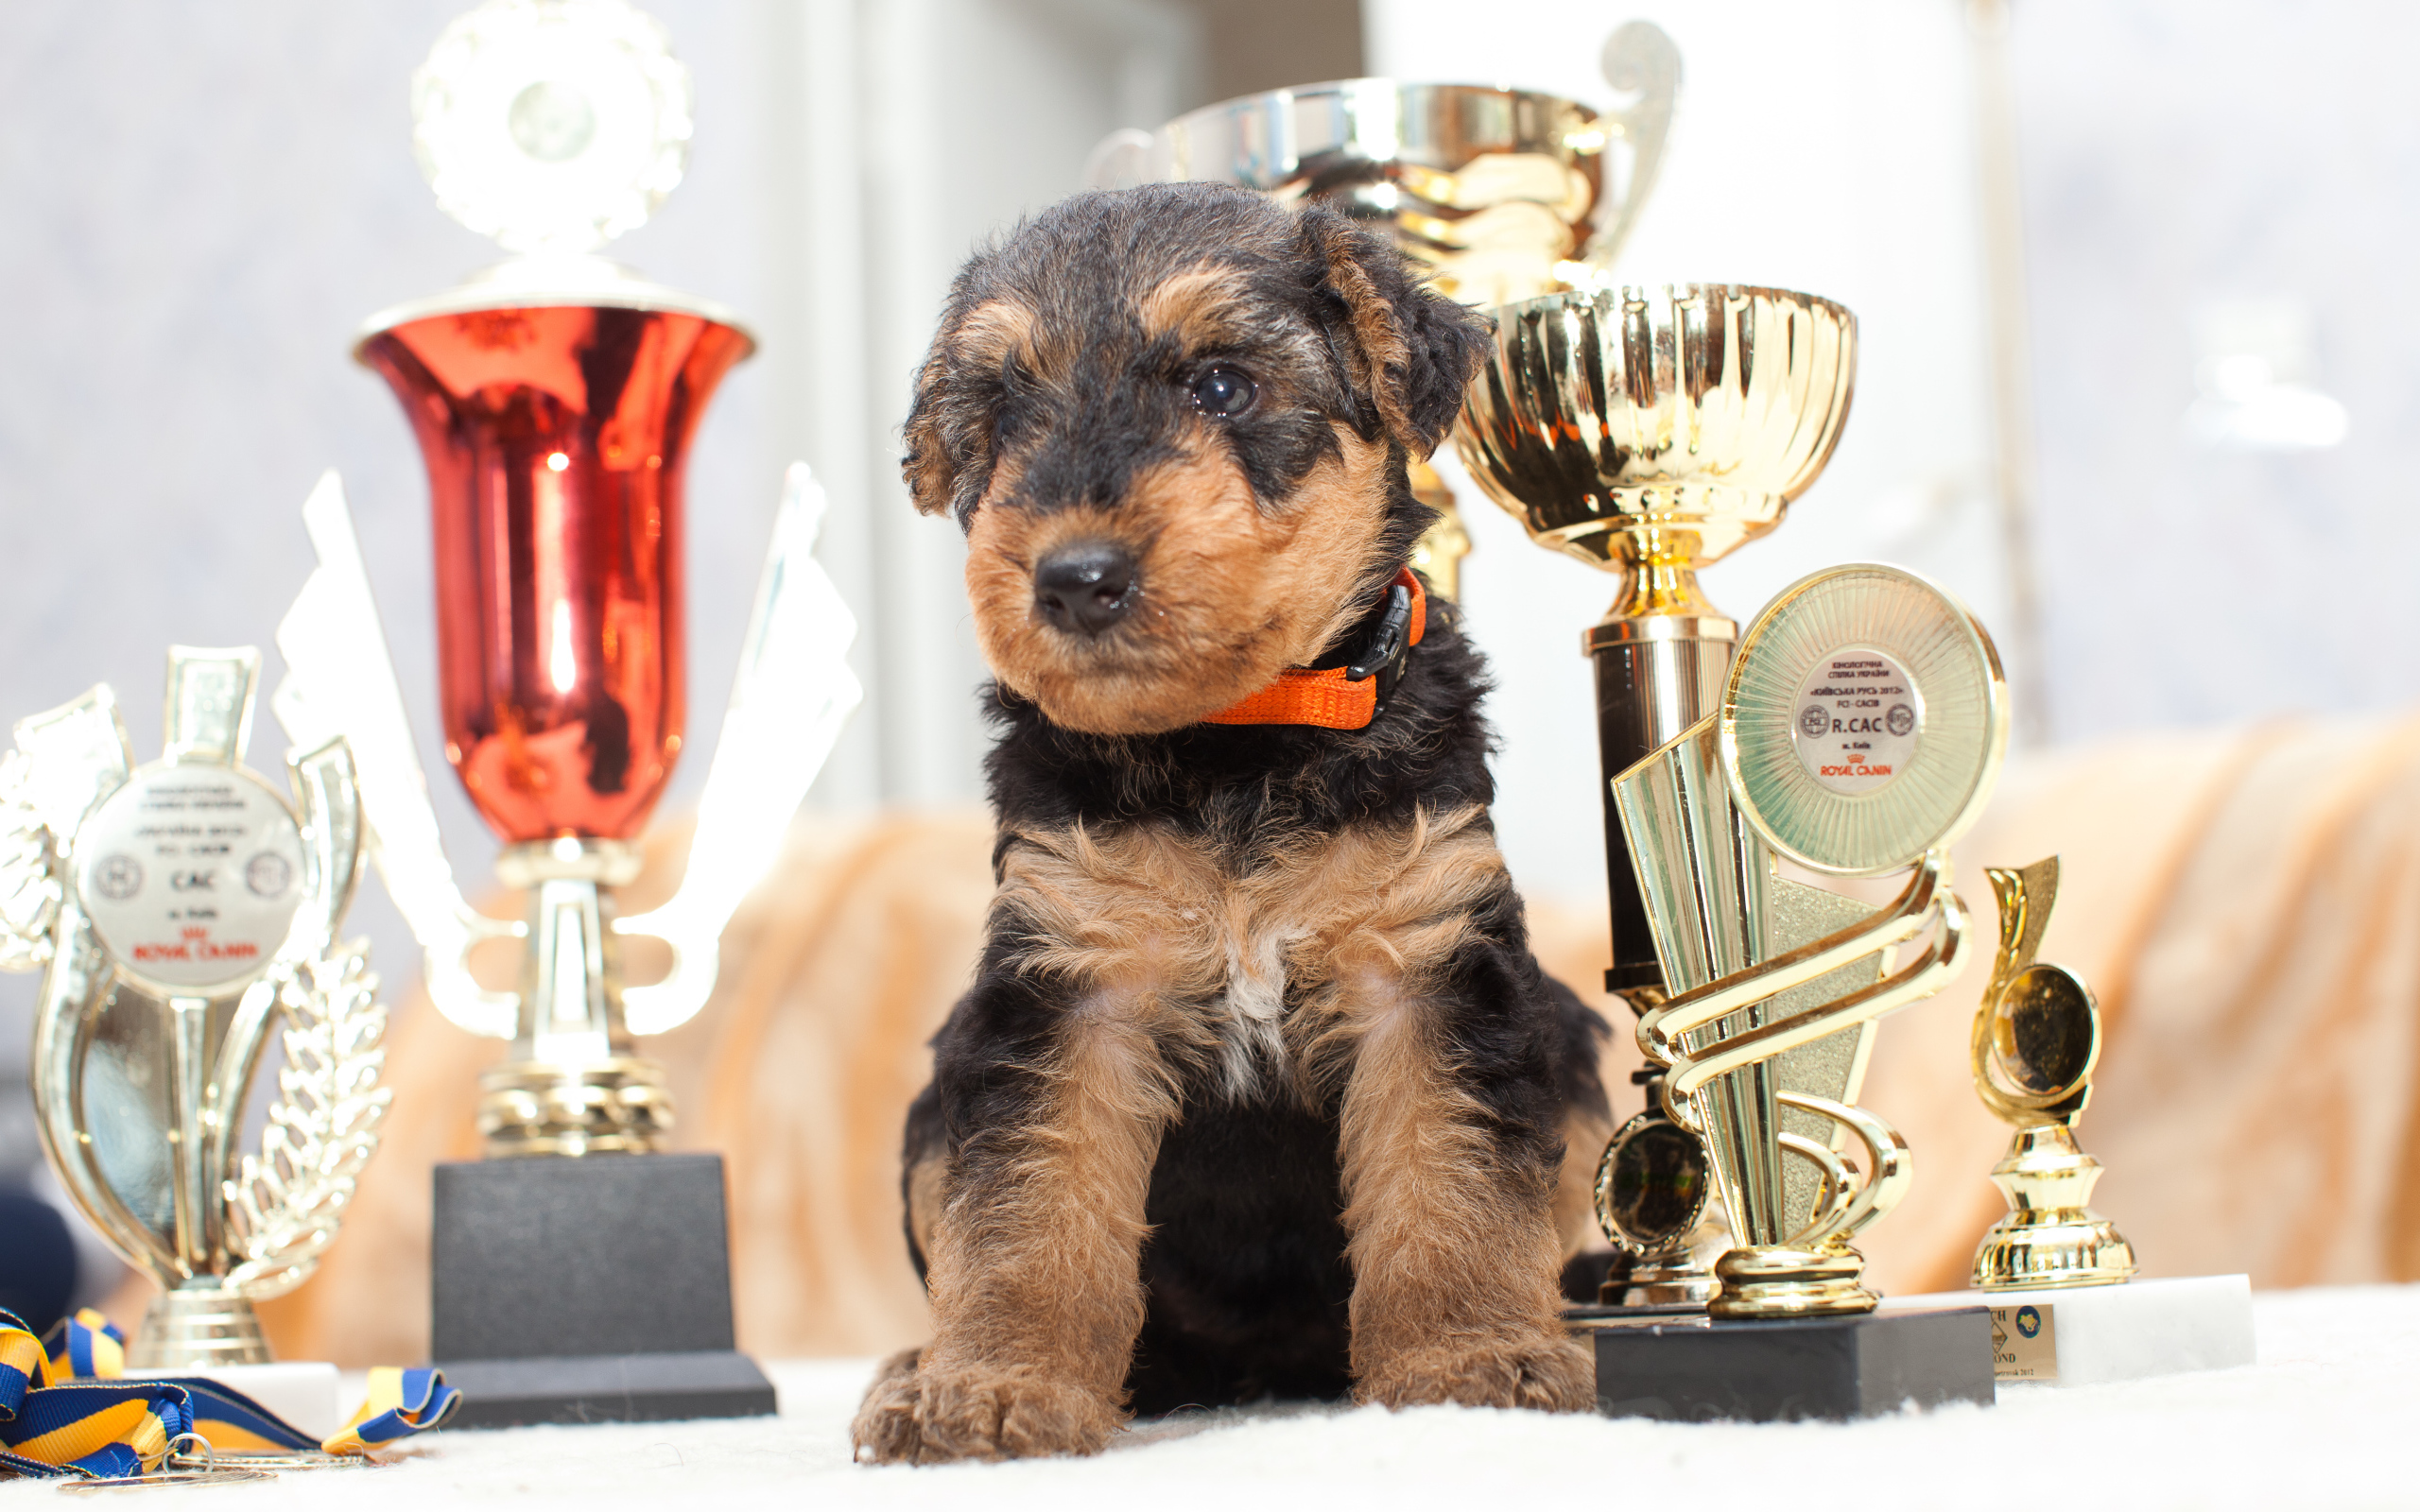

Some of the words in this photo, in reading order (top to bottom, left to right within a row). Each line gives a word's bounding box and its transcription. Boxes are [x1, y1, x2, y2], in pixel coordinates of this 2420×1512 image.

[1857, 669, 1890, 678] УКРАЇНИ
[1821, 765, 1854, 776] ROYAL
[1857, 765, 1892, 776] CANIN
